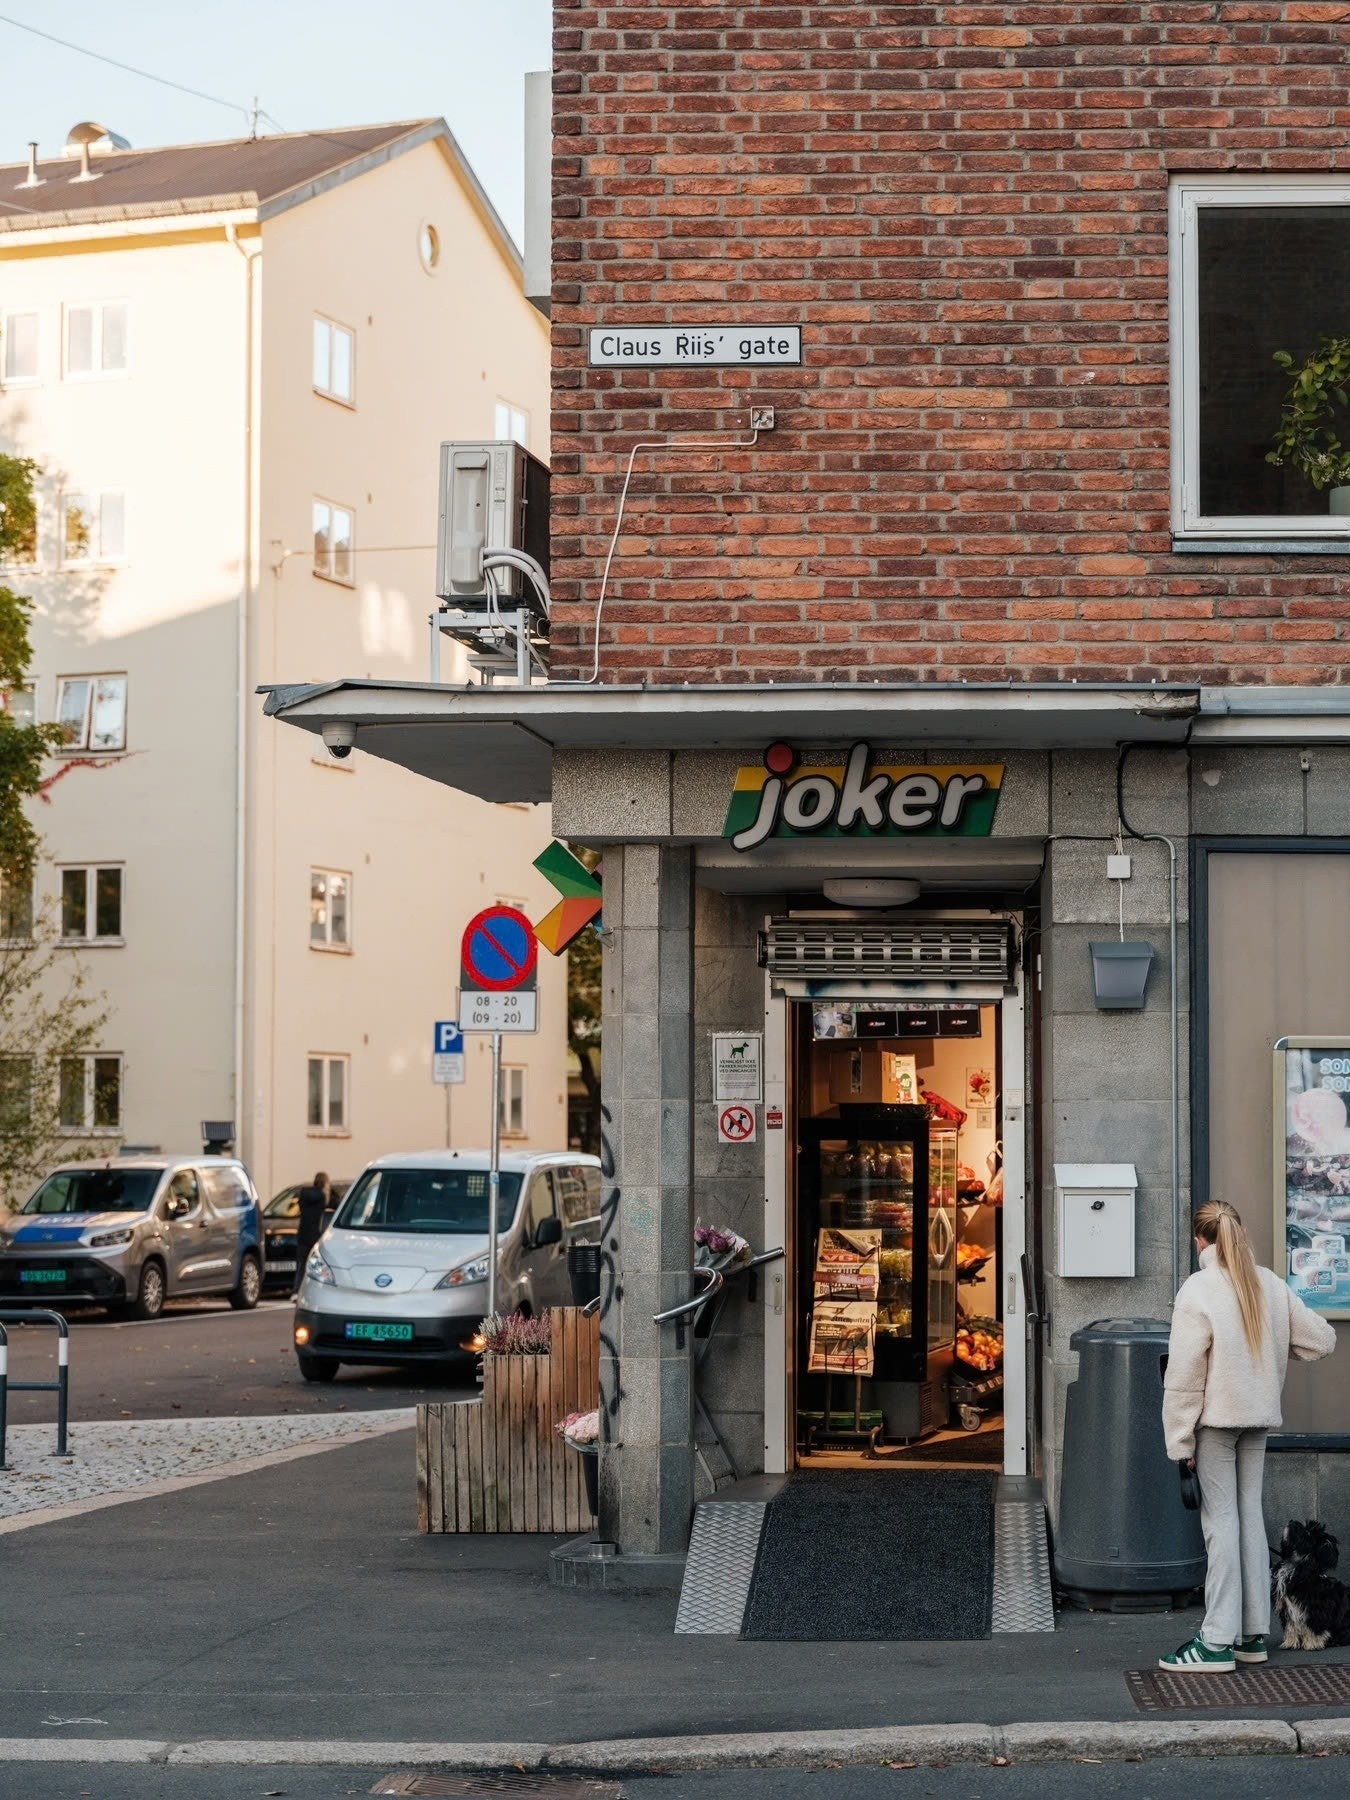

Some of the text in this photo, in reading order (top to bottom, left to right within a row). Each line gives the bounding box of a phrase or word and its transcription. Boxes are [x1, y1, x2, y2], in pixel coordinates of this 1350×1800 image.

[600, 336, 662, 357] Claus
[738, 335, 790, 360] gate
[732, 742, 988, 851] joker
[476, 996, 490, 1007] 08
[503, 996, 518, 1007] 20
[472, 1011, 490, 1024] (09
[503, 1011, 521, 1024] 20)
[441, 1024, 458, 1050] P
[355, 1325, 367, 1336] EF
